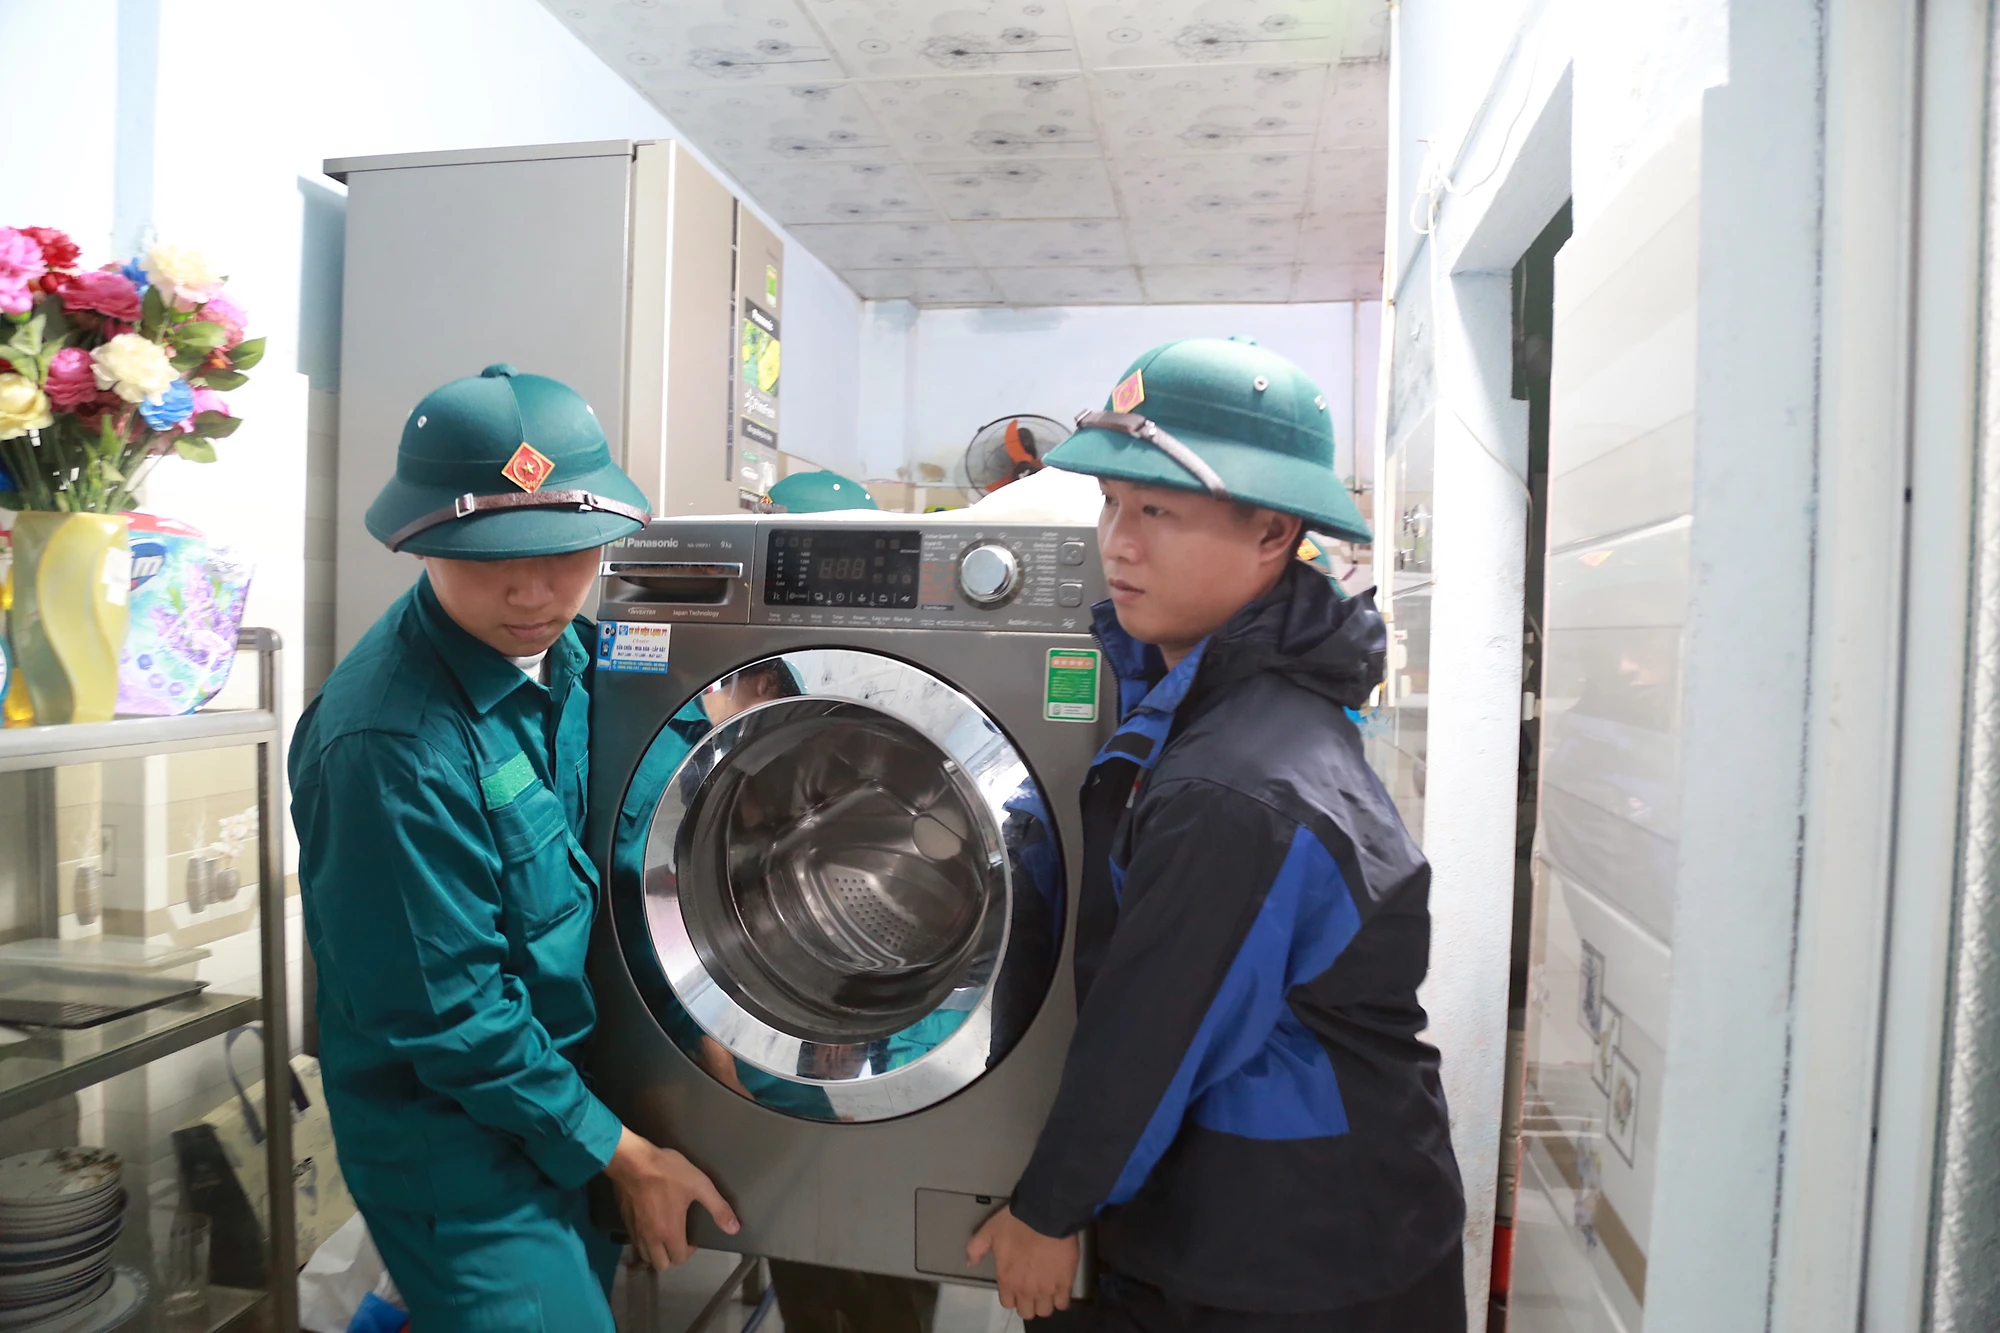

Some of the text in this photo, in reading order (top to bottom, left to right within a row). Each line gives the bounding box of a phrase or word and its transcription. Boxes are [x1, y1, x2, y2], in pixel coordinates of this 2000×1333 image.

[627, 537, 679, 548] Panasonic
[672, 609, 720, 618] Japan Technology
